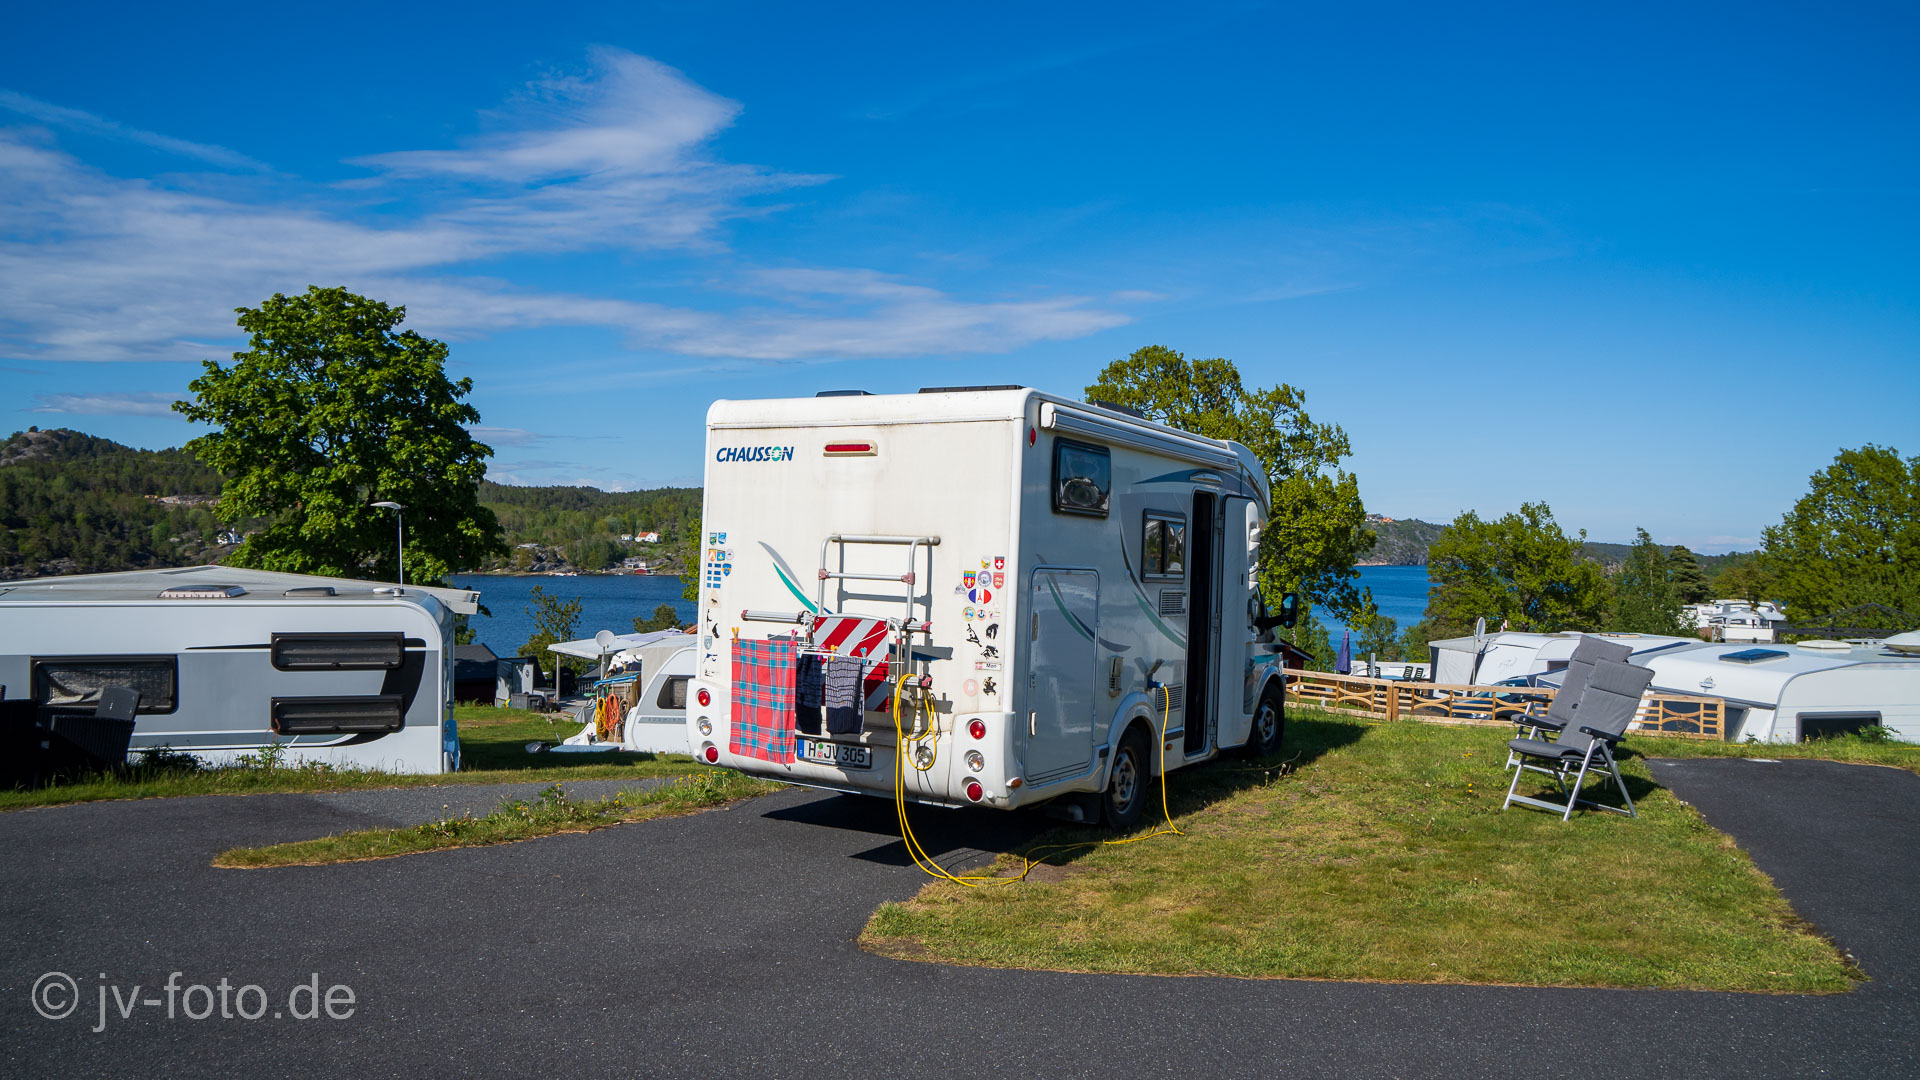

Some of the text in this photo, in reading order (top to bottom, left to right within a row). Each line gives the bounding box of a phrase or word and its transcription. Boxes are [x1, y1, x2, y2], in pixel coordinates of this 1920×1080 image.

[716, 446, 794, 462] CHAUSSON
[808, 742, 865, 763] H JV 305
